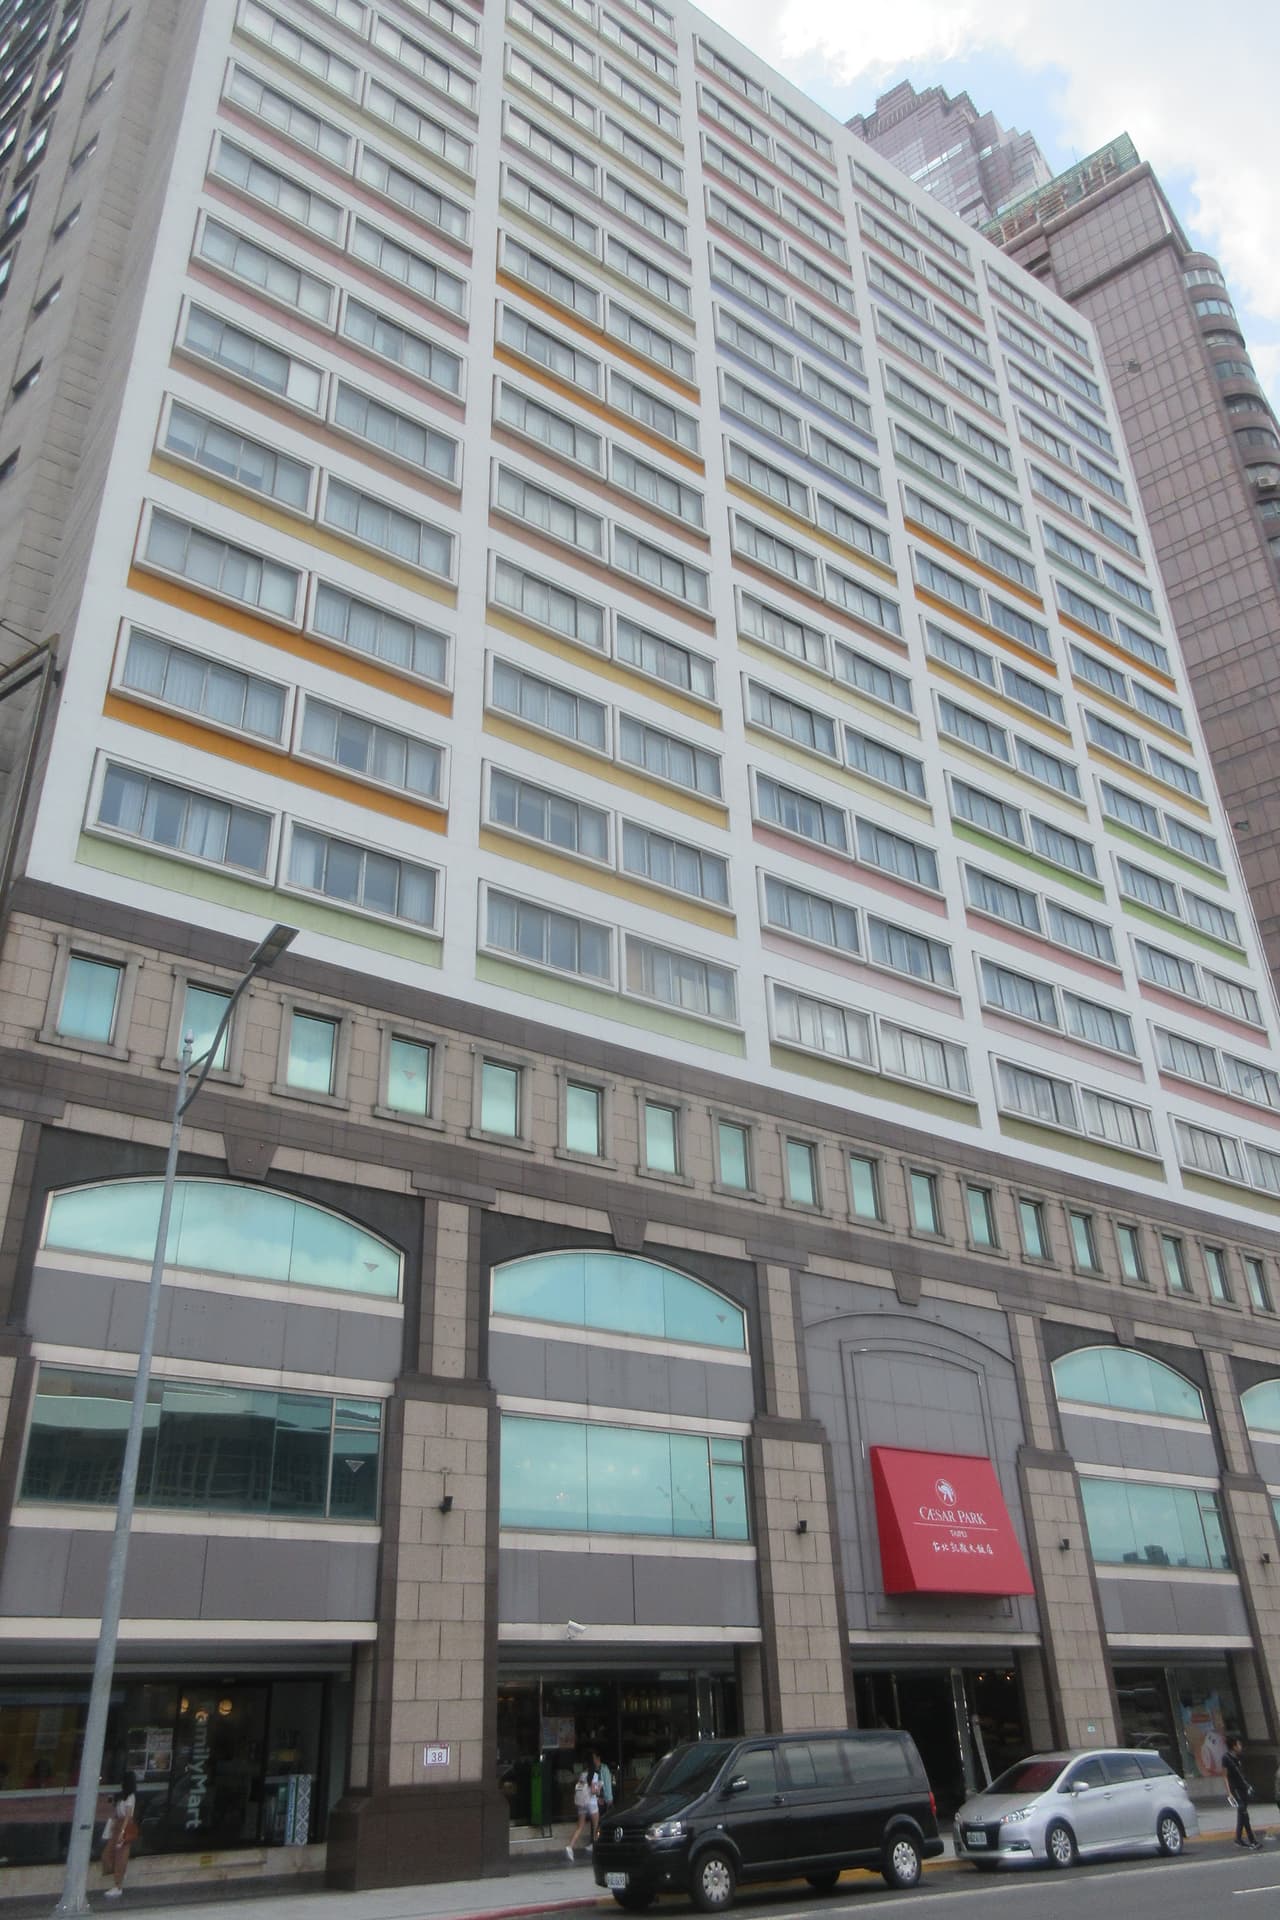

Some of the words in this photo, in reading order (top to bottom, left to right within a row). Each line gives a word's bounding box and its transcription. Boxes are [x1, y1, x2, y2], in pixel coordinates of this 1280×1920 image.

[957, 1510, 987, 1525] PARK
[185, 1700, 213, 1829] milyMart
[432, 1752, 443, 1762] 38
